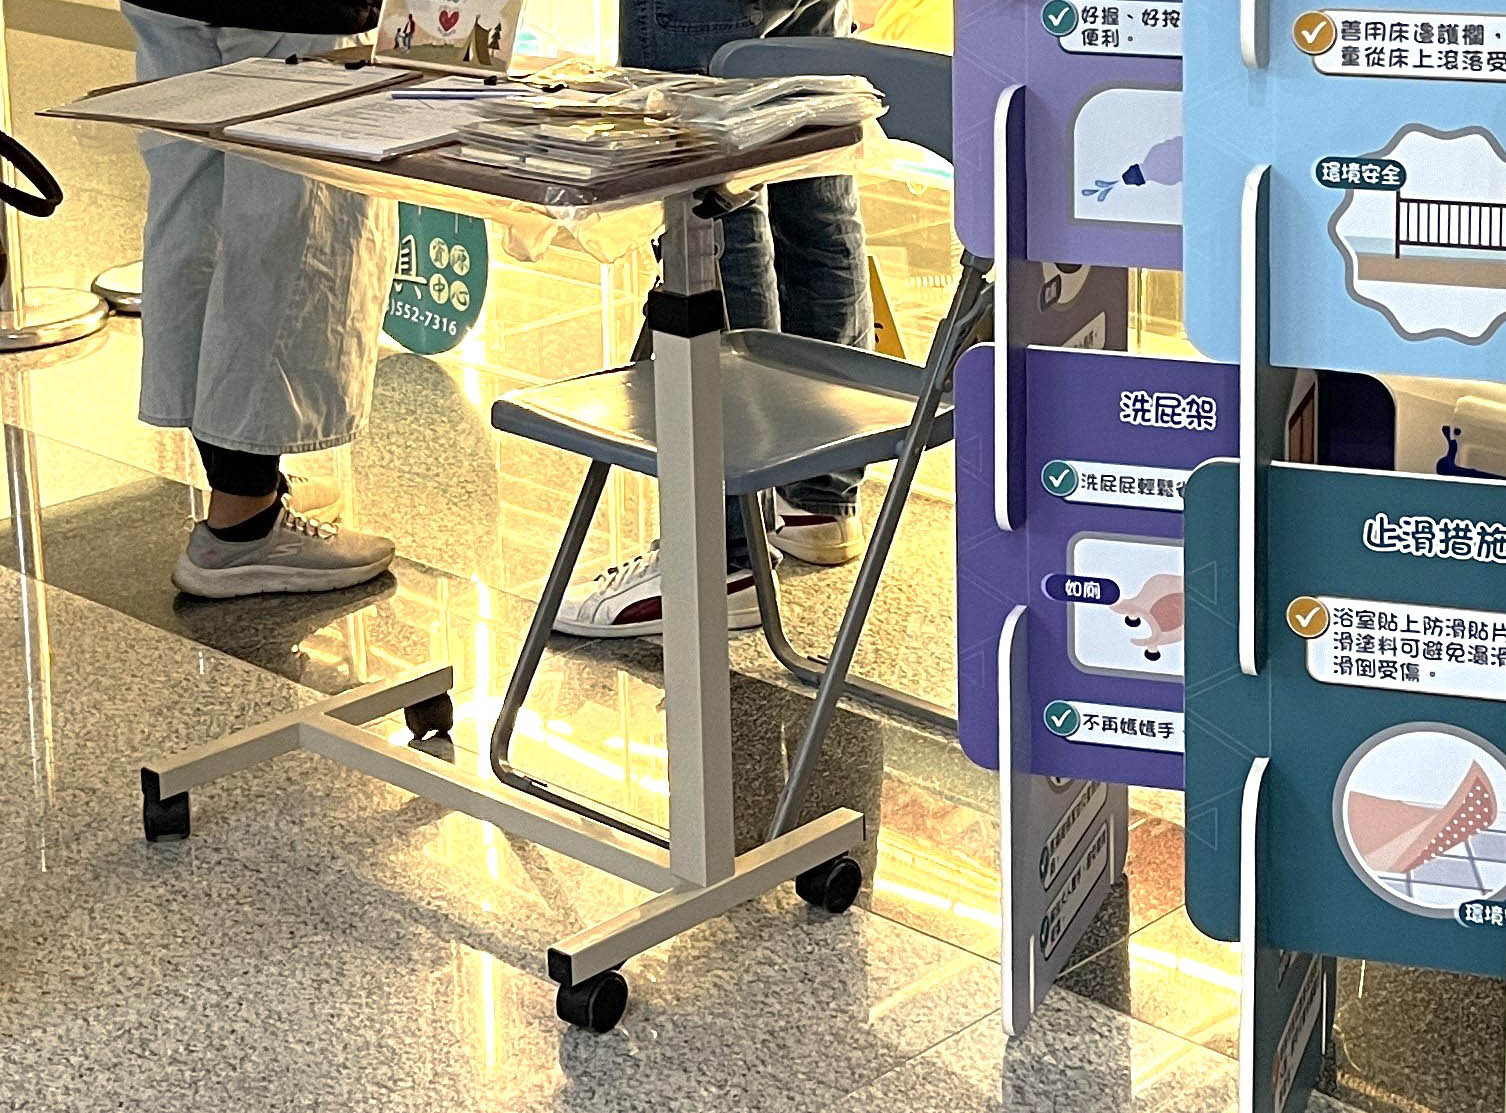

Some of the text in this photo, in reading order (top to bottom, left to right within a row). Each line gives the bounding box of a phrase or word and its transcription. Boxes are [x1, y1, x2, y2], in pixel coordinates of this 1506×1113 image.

[1081, 5, 1181, 29] 好握、好按
[1081, 28, 1134, 48] 便利。
[1321, 161, 1401, 186] 環境安全
[1121, 392, 1216, 430] 洗屁架
[1065, 579, 1101, 600] 如廁
[1334, 656, 1436, 683] 滑倒受傷。
